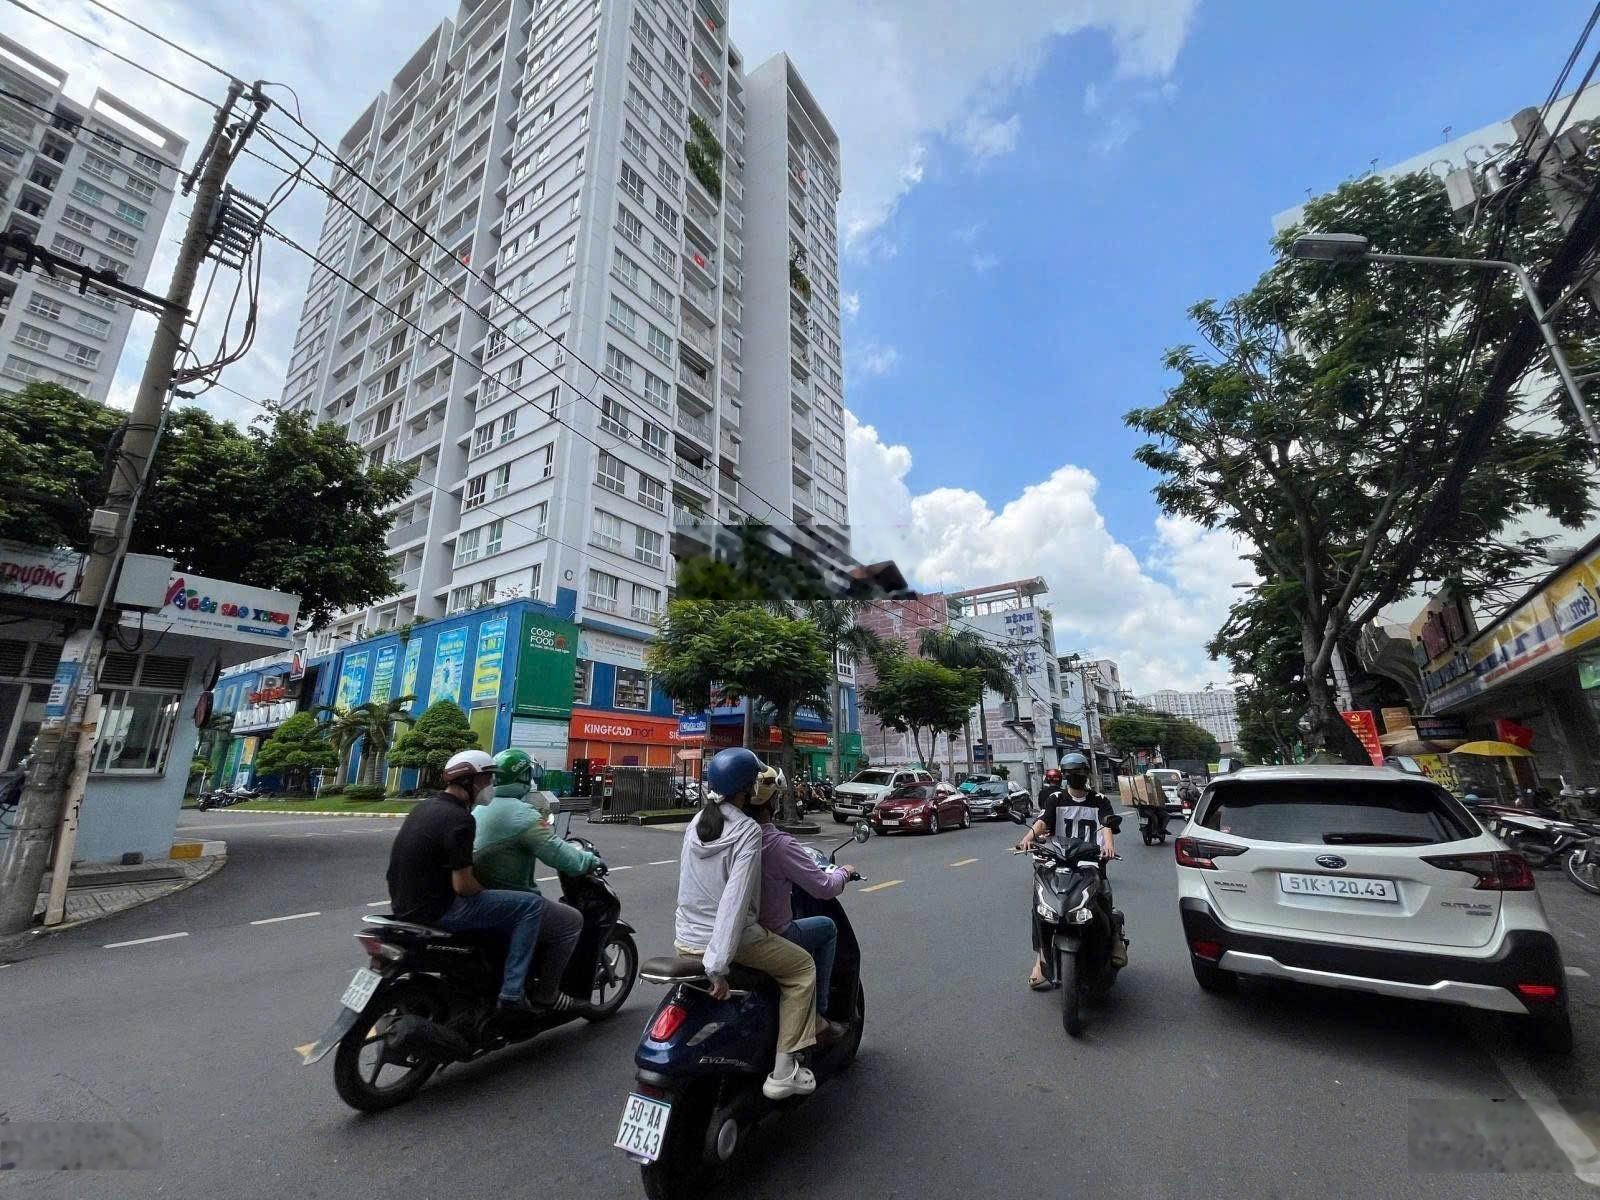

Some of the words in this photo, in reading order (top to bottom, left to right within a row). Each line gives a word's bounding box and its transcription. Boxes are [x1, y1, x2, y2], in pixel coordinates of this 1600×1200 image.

[530, 636, 554, 647] FOOD
[1289, 876, 1386, 897] 51K-120.43
[619, 1122, 660, 1155] 775.43
